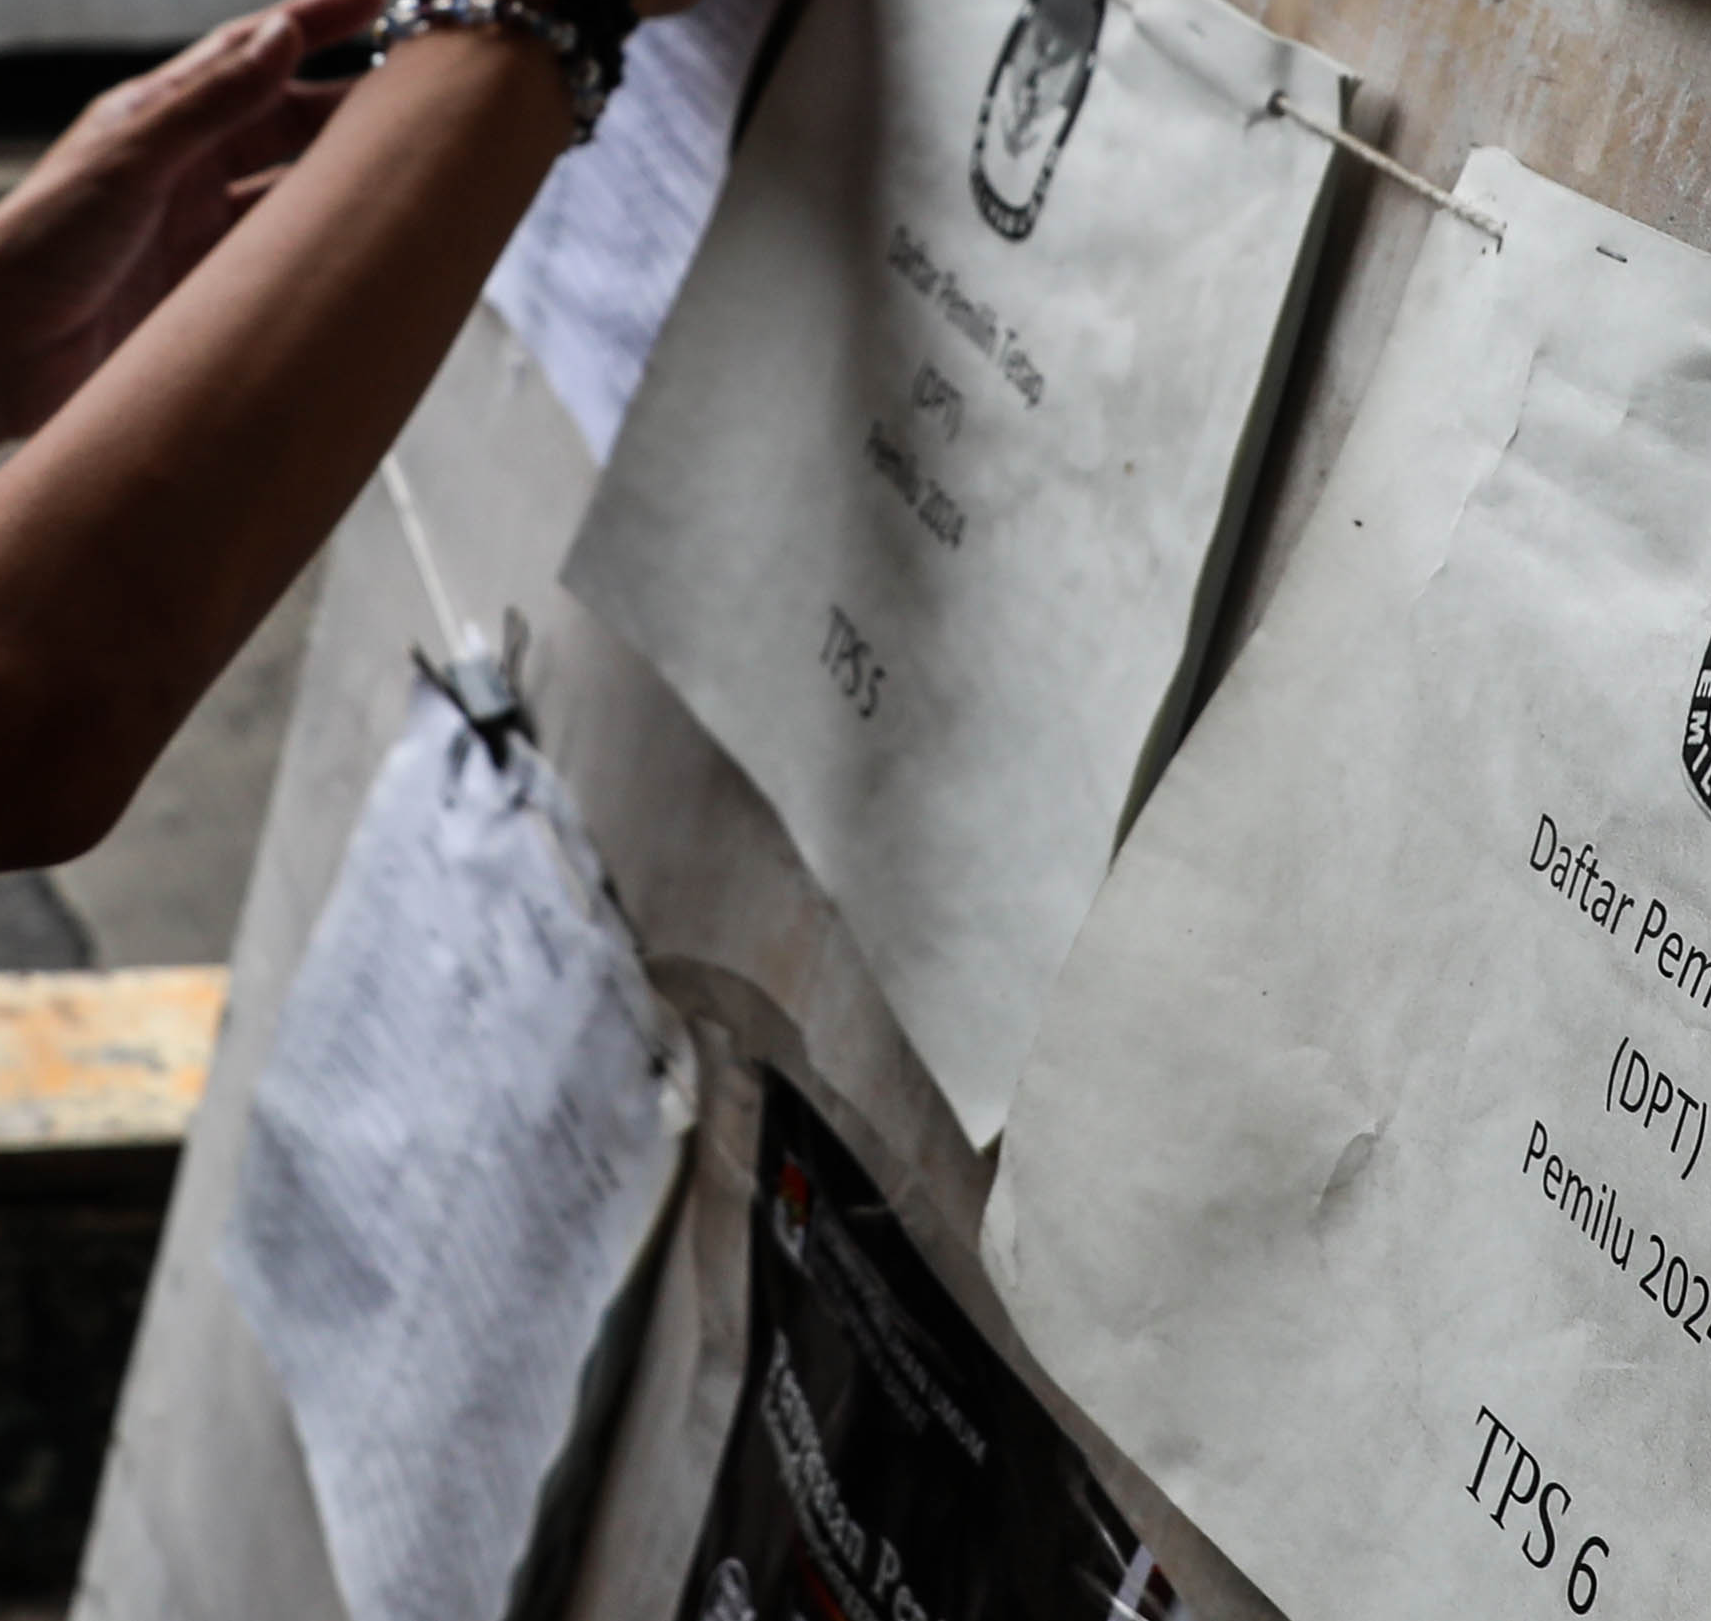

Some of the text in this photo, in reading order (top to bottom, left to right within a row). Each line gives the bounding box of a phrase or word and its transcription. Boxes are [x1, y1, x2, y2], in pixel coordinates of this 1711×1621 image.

[820, 603, 887, 721] TPS 5
[1529, 813, 1635, 937] Daftar
[1605, 1036, 1709, 1180] (DPT)
[1522, 1120, 1635, 1272] Pemilu
[1465, 1405, 1610, 1616] TPS 6
